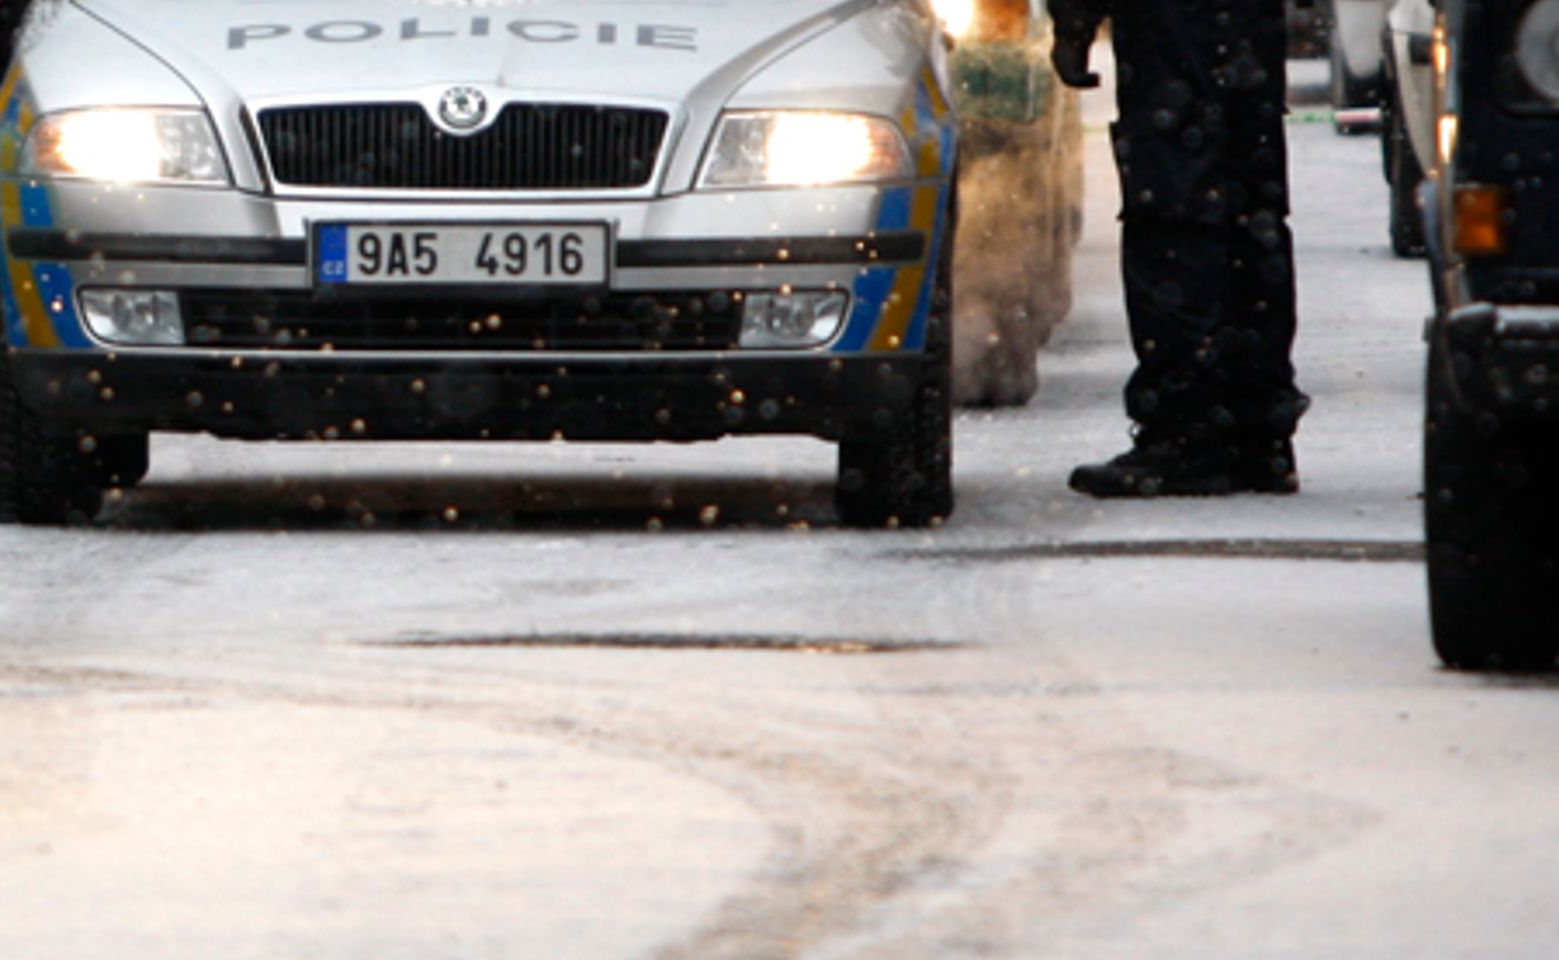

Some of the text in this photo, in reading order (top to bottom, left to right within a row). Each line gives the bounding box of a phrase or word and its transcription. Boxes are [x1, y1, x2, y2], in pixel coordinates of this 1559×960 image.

[227, 16, 698, 53] POLICIE
[357, 231, 584, 277] 9A5 4916
